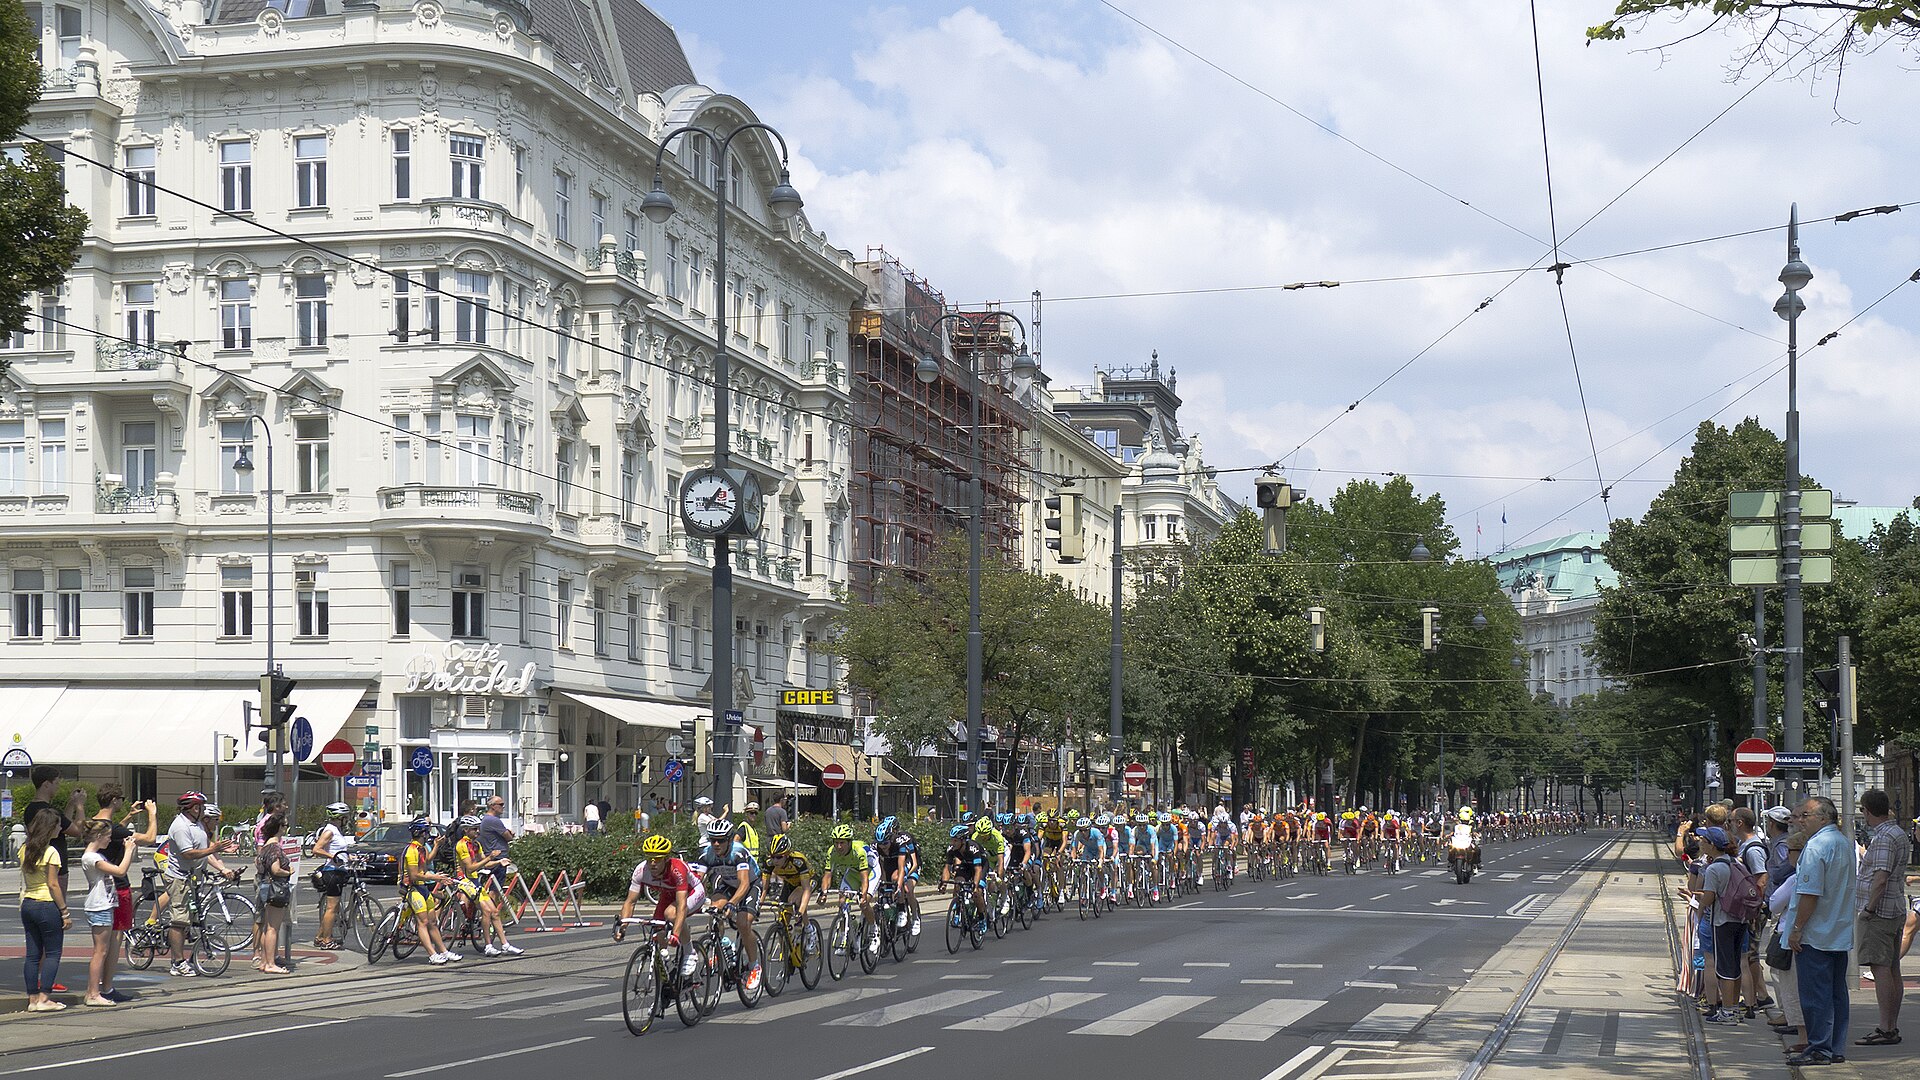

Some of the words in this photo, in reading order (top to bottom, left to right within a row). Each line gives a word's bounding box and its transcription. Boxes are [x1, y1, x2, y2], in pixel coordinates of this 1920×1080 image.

[405, 653, 537, 693] Prückel
[443, 640, 502, 675] Café
[818, 726, 848, 744] MILANO
